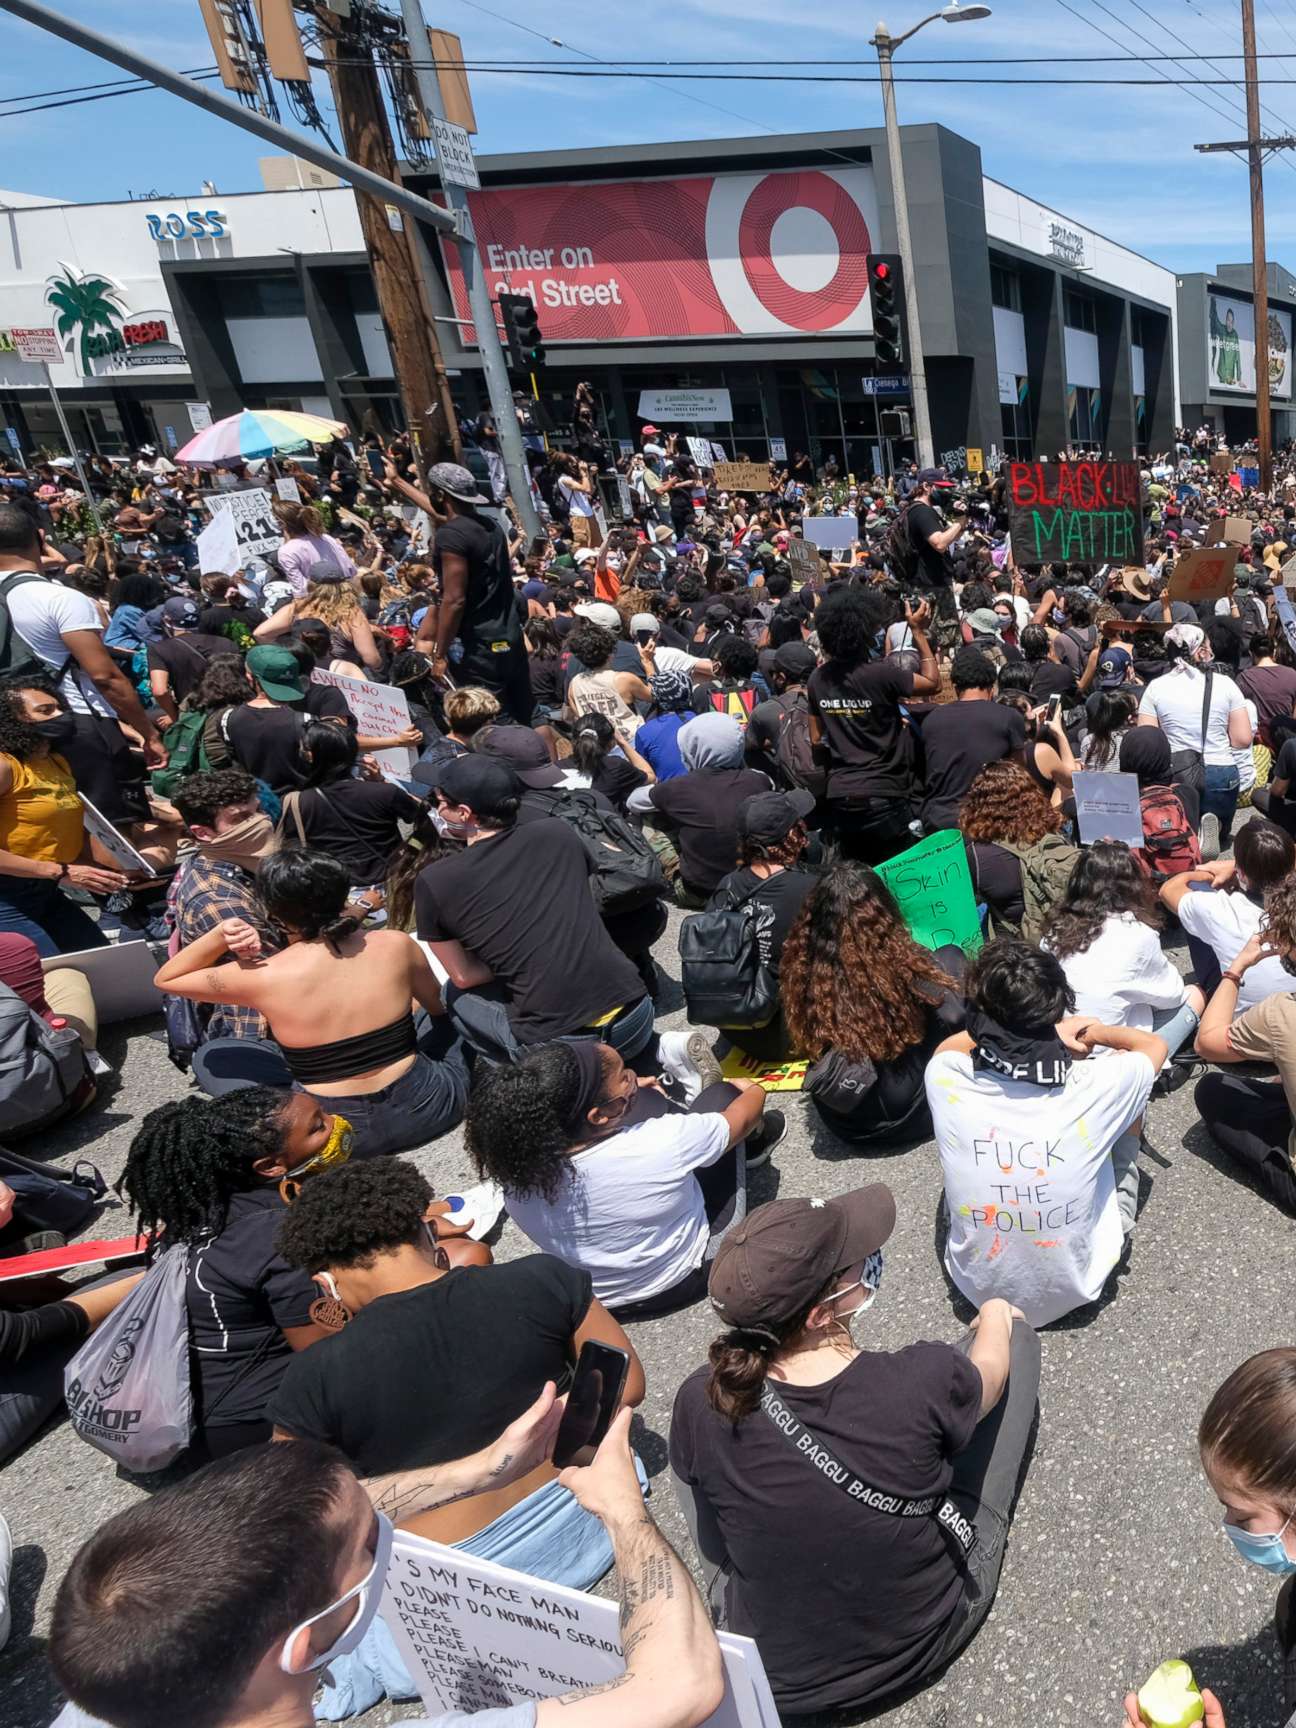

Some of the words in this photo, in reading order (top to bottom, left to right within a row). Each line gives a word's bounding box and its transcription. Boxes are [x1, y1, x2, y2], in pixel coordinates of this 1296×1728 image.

[441, 145, 471, 163] BLOCK
[145, 210, 225, 241] ROSS
[486, 244, 554, 273] Enter
[560, 246, 595, 269] on
[541, 278, 623, 308] Street
[15, 336, 28, 346] NO
[123, 320, 167, 344] FRESH
[1010, 462, 1110, 512] BLACK
[1031, 507, 1136, 562] MATTER
[819, 700, 841, 708] ONE
[859, 700, 872, 708] UP
[894, 861, 962, 901] Skin
[973, 1138, 1065, 1170] FUCK
[990, 1183, 1052, 1204] THE
[972, 1198, 1081, 1232] POLICE
[65, 1377, 142, 1432] BISHOP
[795, 1433, 850, 1485] BAGGU
[847, 1478, 904, 1515] BAGGU
[937, 1502, 978, 1549] BAGGU
[428, 1565, 458, 1589] MY
[467, 1576, 523, 1605] FACE
[531, 1595, 580, 1622] MAN
[394, 1596, 453, 1624] PLEASE
[400, 1581, 462, 1611] DIDN'T
[465, 1598, 493, 1619] DO
[566, 1627, 625, 1658] SERIOU
[400, 1612, 463, 1640] PLEASE
[406, 1627, 470, 1653] PLEASE
[489, 1652, 530, 1673] CAN'T
[414, 1643, 478, 1670] PLEASE
[421, 1657, 475, 1683] PLEASE
[427, 1670, 478, 1697] PLEASE
